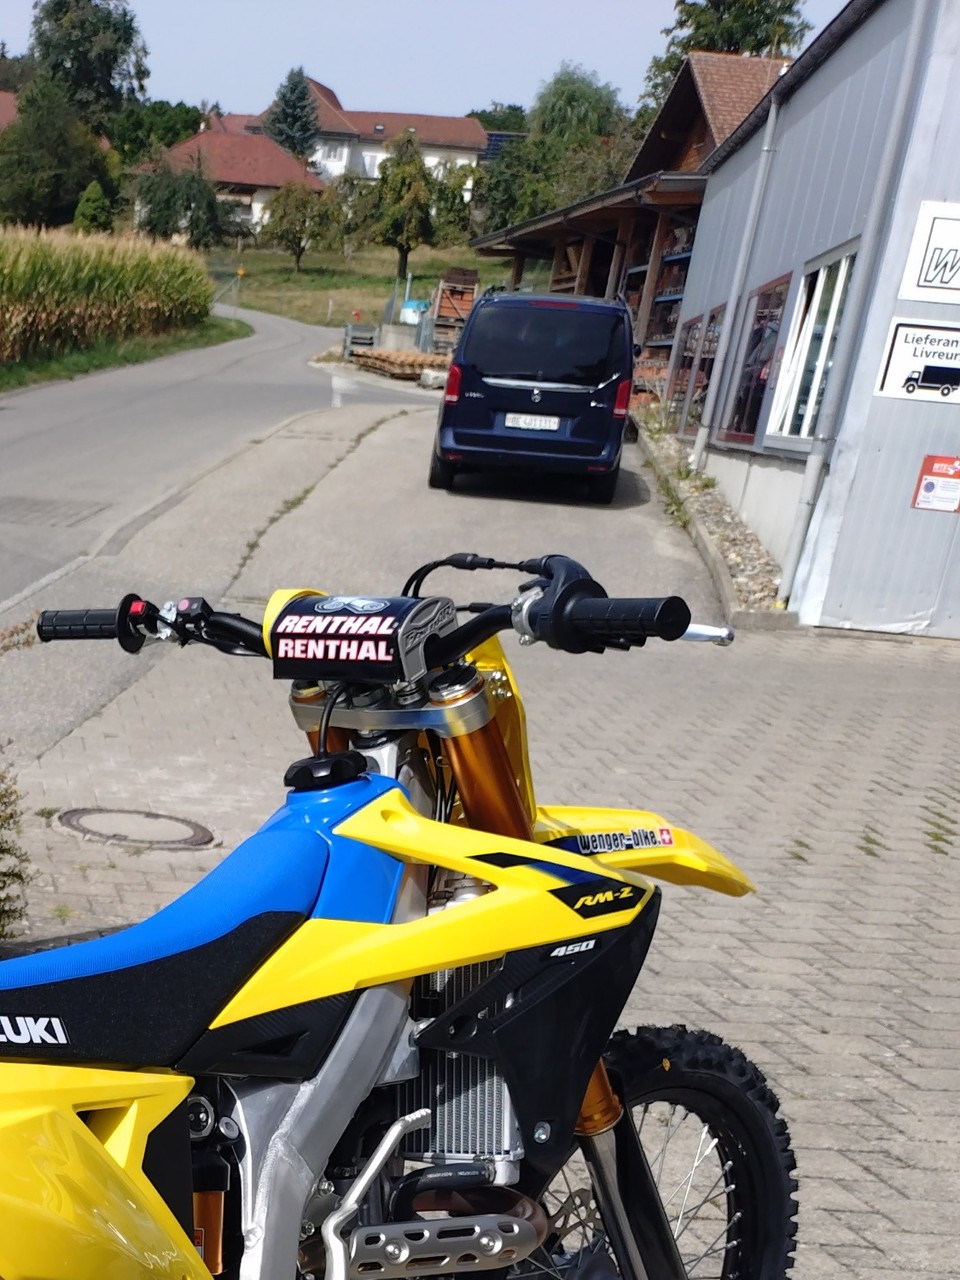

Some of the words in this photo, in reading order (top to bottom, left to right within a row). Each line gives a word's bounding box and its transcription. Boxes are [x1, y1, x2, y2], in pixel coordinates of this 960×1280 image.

[904, 332, 960, 349] Lieferan
[912, 346, 960, 361] Livreur
[276, 615, 397, 635] RENTHAL
[277, 638, 394, 662] RENTHAL
[573, 886, 634, 910] RM-Z
[550, 939, 597, 957] 450
